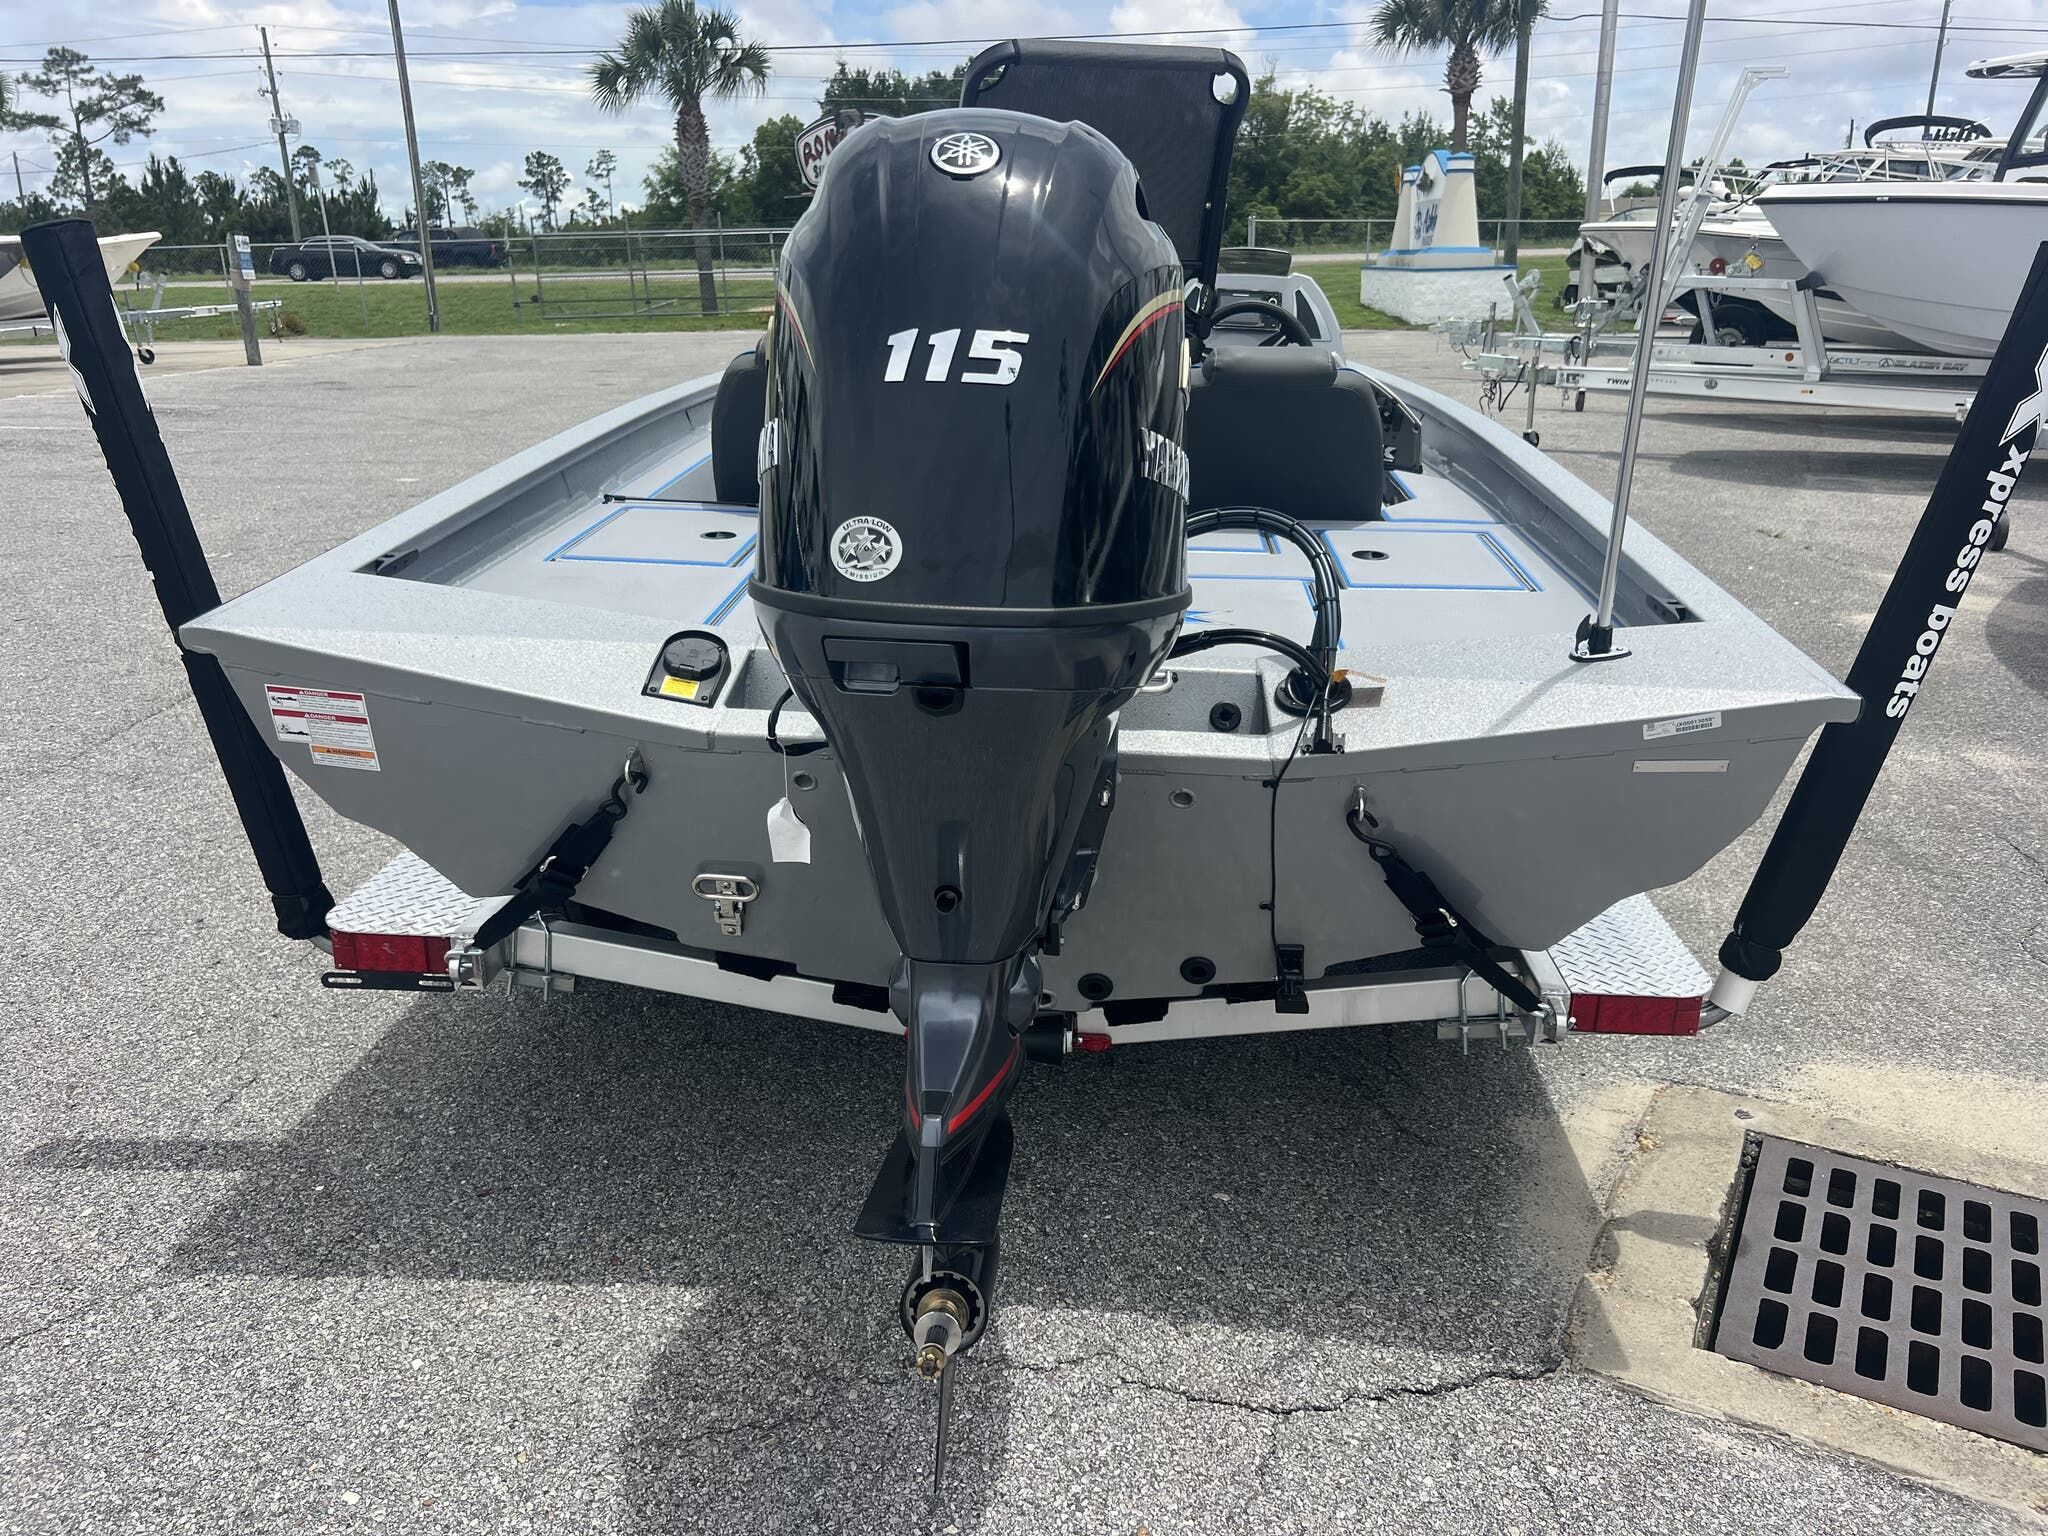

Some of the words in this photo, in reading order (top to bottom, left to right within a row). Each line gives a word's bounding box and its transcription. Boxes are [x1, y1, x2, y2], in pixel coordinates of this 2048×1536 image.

[884, 328, 1030, 386] 115
[1606, 378, 1630, 386] TWIN
[1945, 444, 2031, 593] xpress
[844, 569, 884, 580] EMISSION
[1886, 604, 1957, 719] boats
[309, 713, 337, 721] DANGER
[333, 748, 361, 757] WARNING
